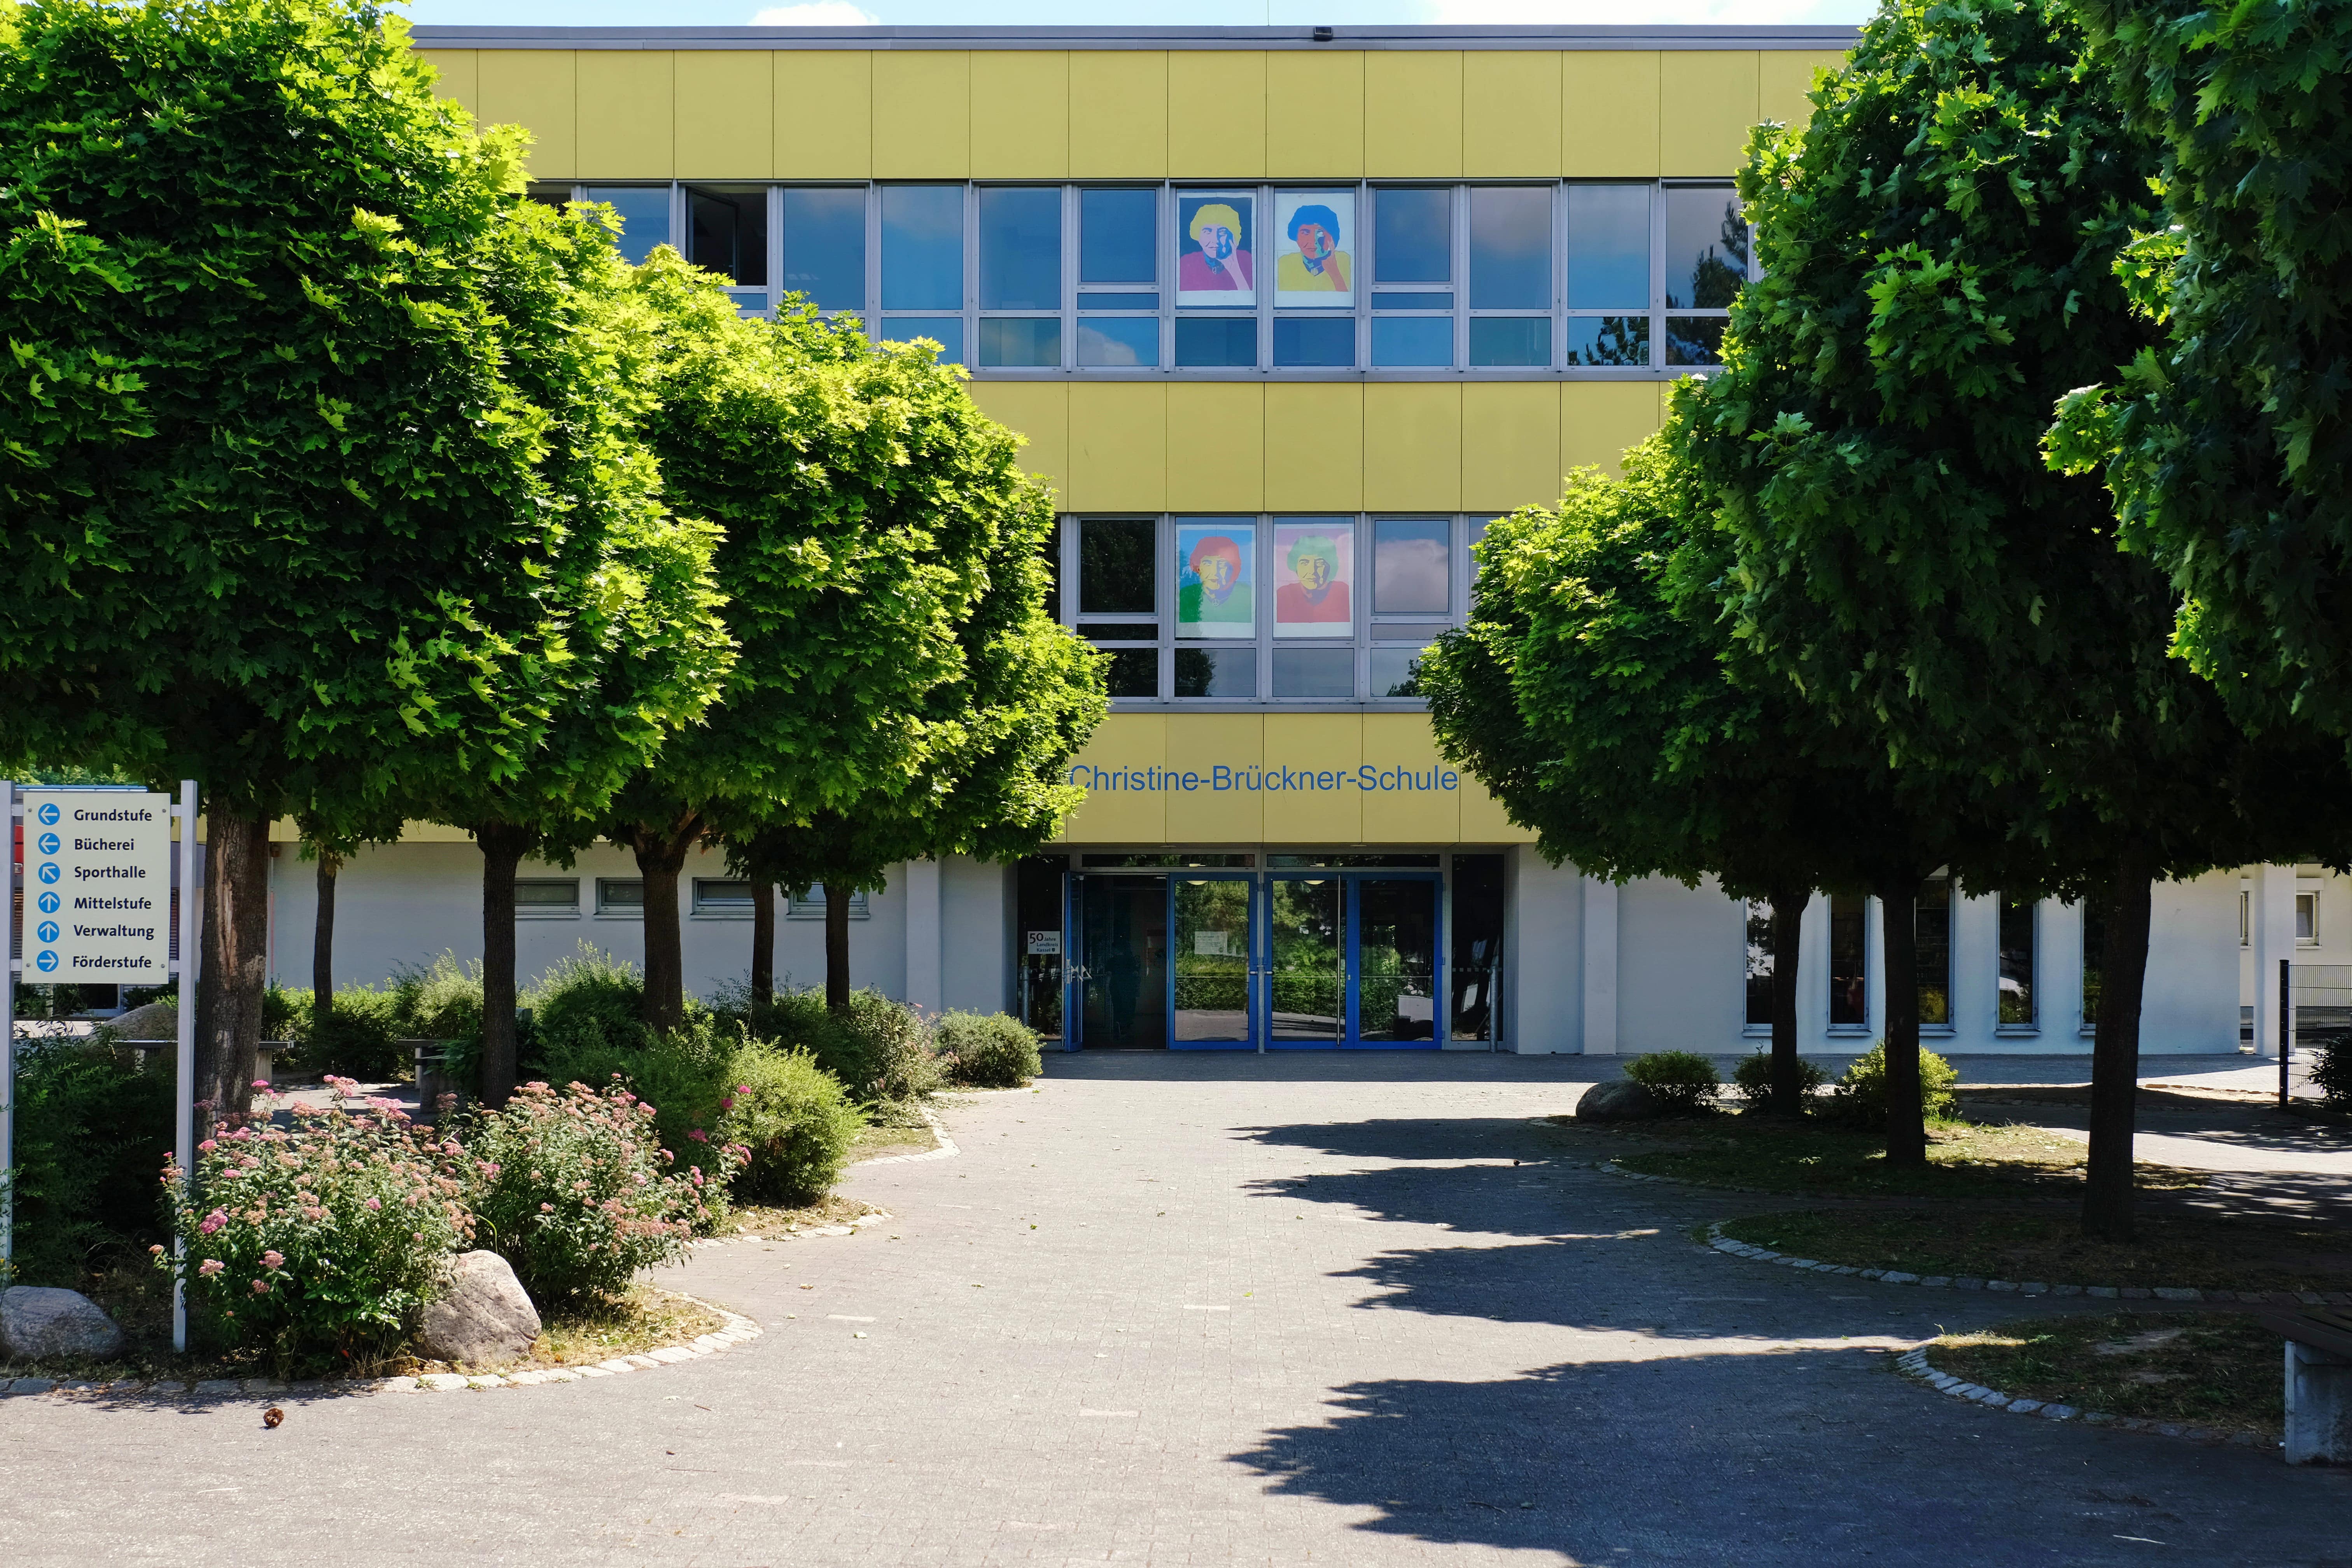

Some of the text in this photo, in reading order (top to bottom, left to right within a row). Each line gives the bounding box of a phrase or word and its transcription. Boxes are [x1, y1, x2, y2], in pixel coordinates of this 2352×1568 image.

[1070, 765, 1458, 791] Christine-Brückner-Schule
[74, 808, 152, 821] Grundstufe
[75, 838, 134, 850] Bücherei
[74, 866, 146, 881] Sporthalle
[74, 897, 152, 909] Mittelstufe
[74, 924, 154, 940] Verwaltung
[1029, 933, 1043, 944] 50
[73, 955, 152, 968] Förderstufe
